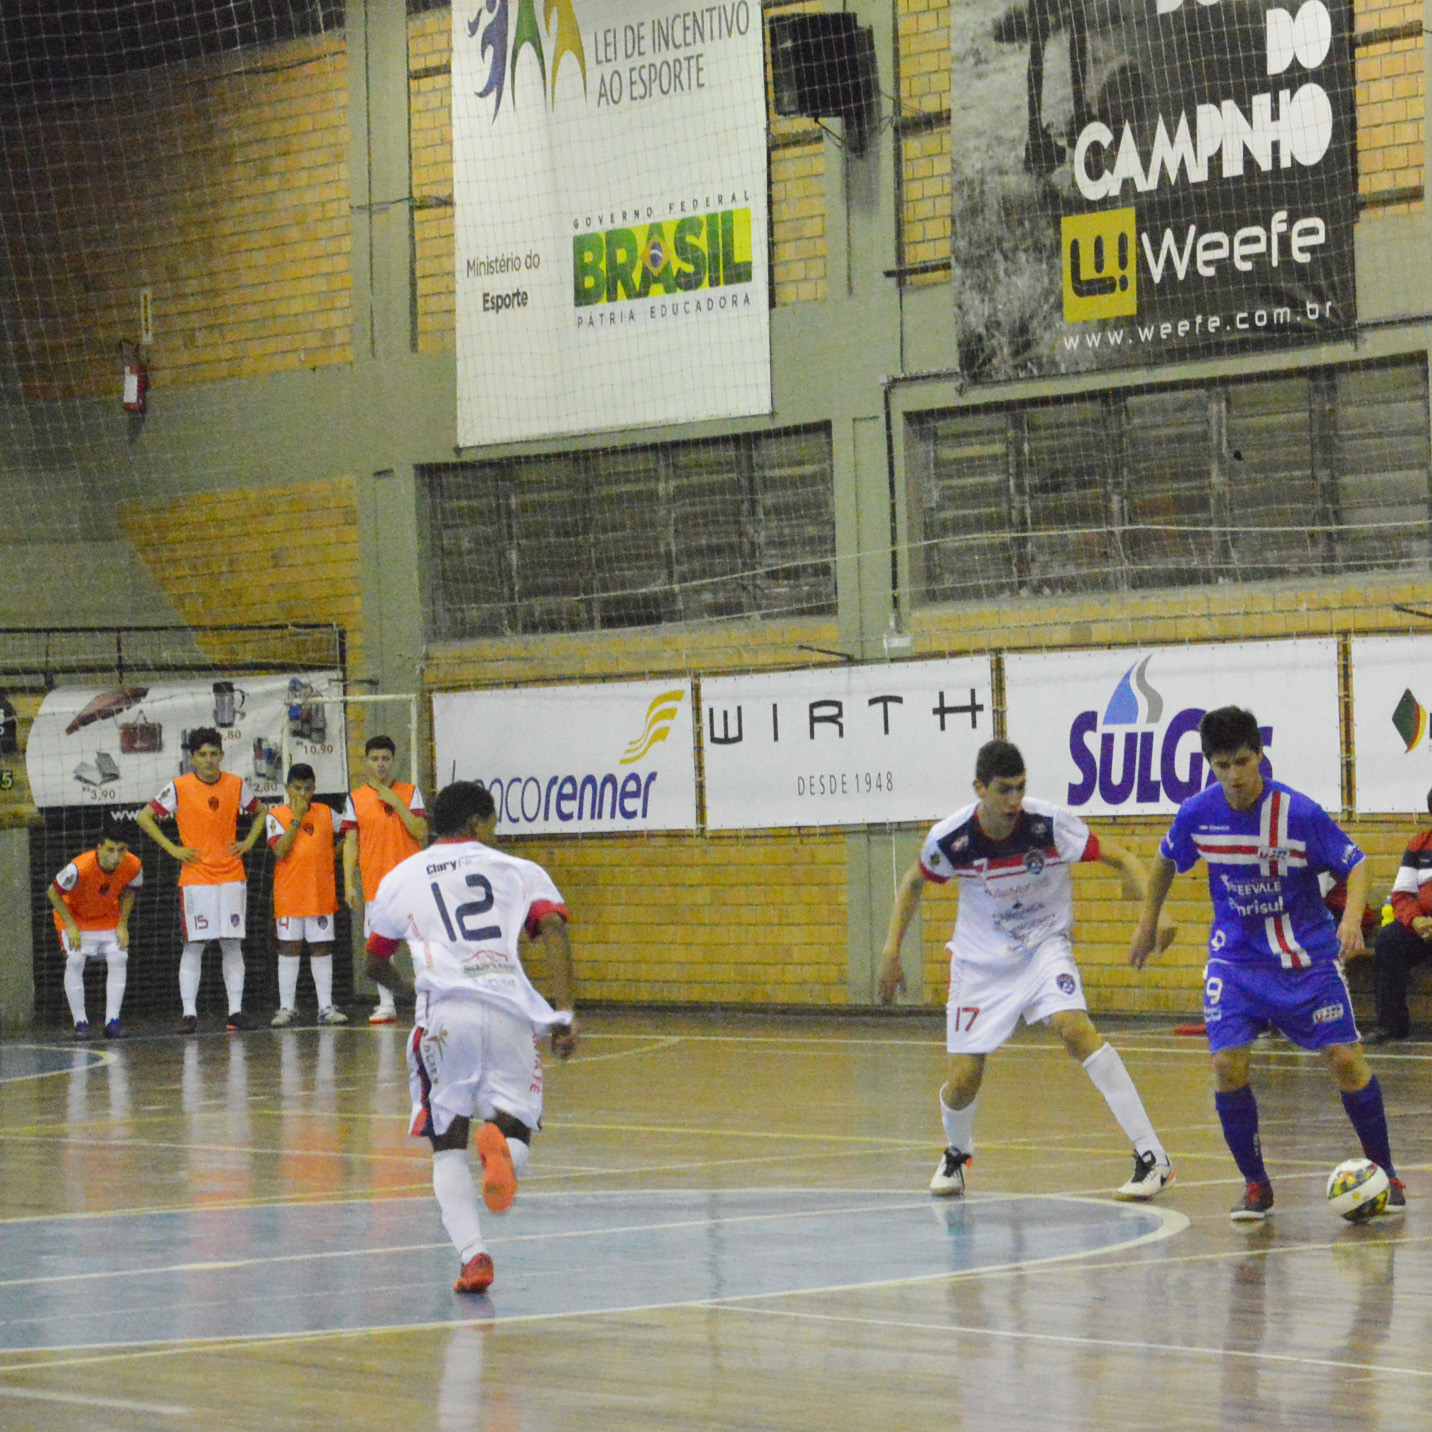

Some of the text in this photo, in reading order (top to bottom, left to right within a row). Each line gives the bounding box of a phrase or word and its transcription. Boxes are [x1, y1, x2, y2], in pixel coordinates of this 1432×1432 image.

[594, 0, 750, 65] LEI DE INCENTIVO
[1266, 0, 1332, 76] DO
[597, 54, 705, 107] AO ESPORTE
[1074, 83, 1333, 200] CAMPINHO
[574, 190, 750, 230] GOVERNO FEDERAL
[466, 250, 541, 279] Ministério do
[573, 207, 752, 308] BRASIL
[1142, 210, 1326, 284] Weefe
[482, 288, 529, 314] Esporte
[650, 292, 751, 319] EDUCADORA
[1063, 300, 1333, 352] www.weefe.com.br
[708, 688, 984, 745] WIRTH
[452, 759, 658, 824] ncorenner
[797, 771, 895, 796] DESDE 1948
[194, 914, 209, 931] 15
[431, 873, 502, 942] 12
[1237, 895, 1283, 917] nrisul
[1206, 976, 1223, 1005] 9
[955, 1007, 981, 1032] 17
